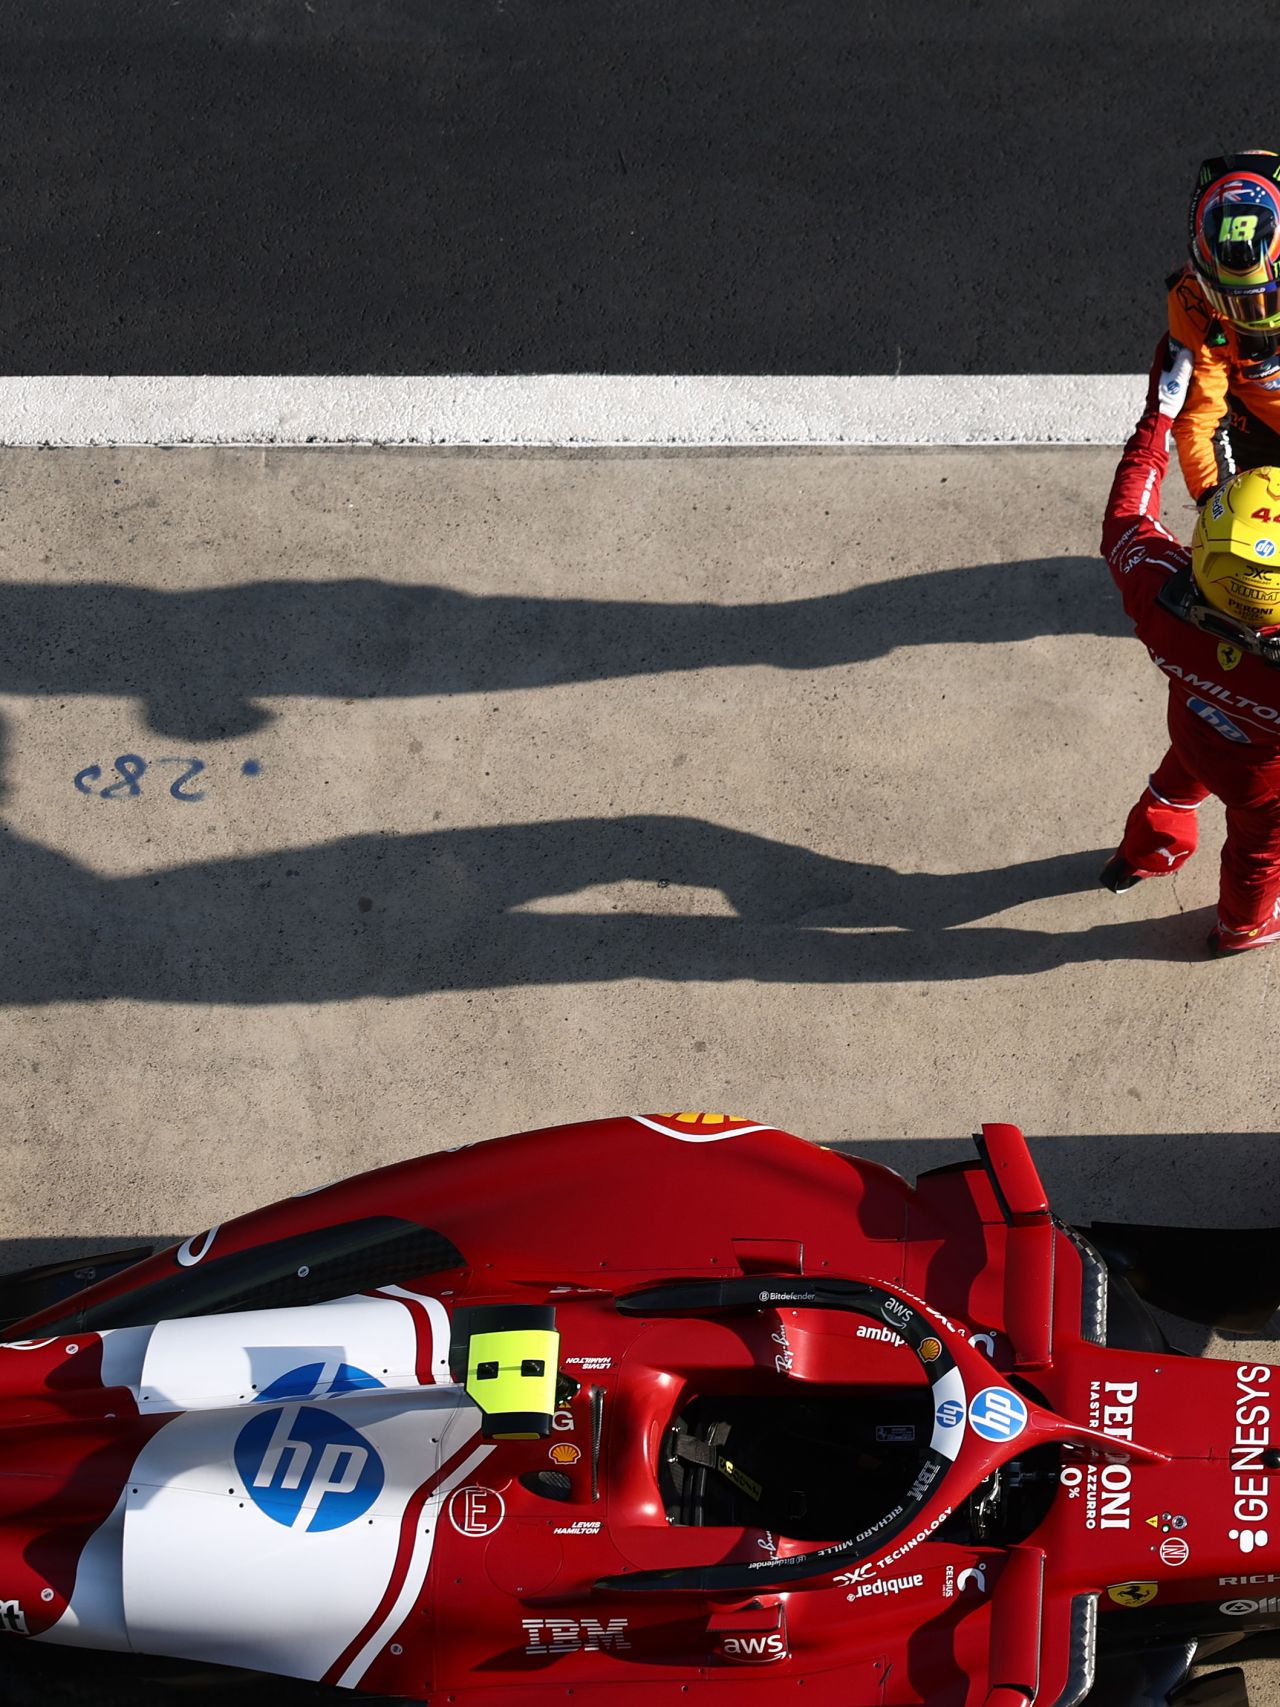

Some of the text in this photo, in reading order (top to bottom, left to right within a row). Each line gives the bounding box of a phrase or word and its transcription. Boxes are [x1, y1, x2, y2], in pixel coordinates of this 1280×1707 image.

[1211, 487, 1226, 520] Credit
[1228, 598, 1274, 615] PERONI
[769, 1291, 816, 1301] Bitdefender
[884, 1296, 914, 1322] aws
[856, 1325, 910, 1348] ambip
[937, 1402, 964, 1427] hp
[970, 1390, 1025, 1438] hp
[1086, 1381, 1101, 1529] NASTR AZZURRO
[1231, 1365, 1271, 1522] GENESYS
[249, 1406, 373, 1532] hp
[907, 1460, 941, 1502] IBM
[553, 1527, 599, 1535] HAMILTON
[572, 1521, 602, 1529] LEWIS
[817, 1505, 904, 1557] RICHARD MILLE
[877, 1506, 953, 1569] TECHNOLOGY
[748, 1557, 796, 1571] Bitdefender
[832, 1562, 877, 1588] DXC
[945, 1565, 954, 1598] CELSIUS
[521, 1618, 632, 1655] IBM
[723, 1634, 784, 1655] aws
